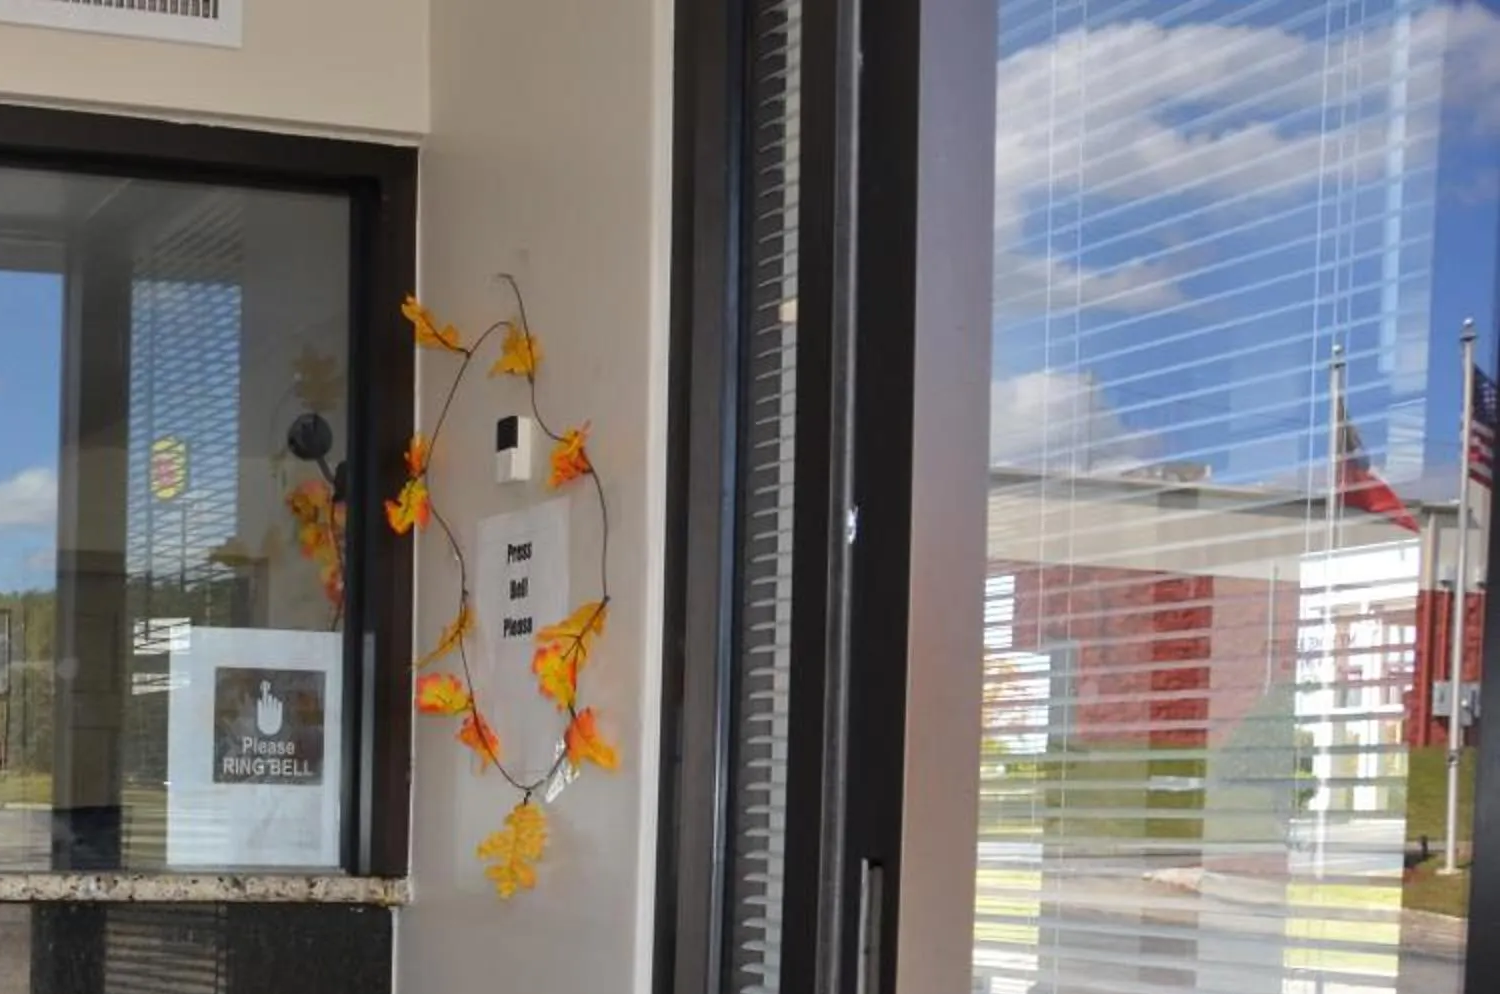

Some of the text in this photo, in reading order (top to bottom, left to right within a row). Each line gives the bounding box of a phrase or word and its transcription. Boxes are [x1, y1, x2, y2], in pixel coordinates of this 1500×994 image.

[507, 541, 533, 564] Press
[509, 577, 529, 600] Bell
[503, 616, 533, 638] Please
[241, 736, 295, 755] Please
[222, 757, 313, 777] RING BELL
